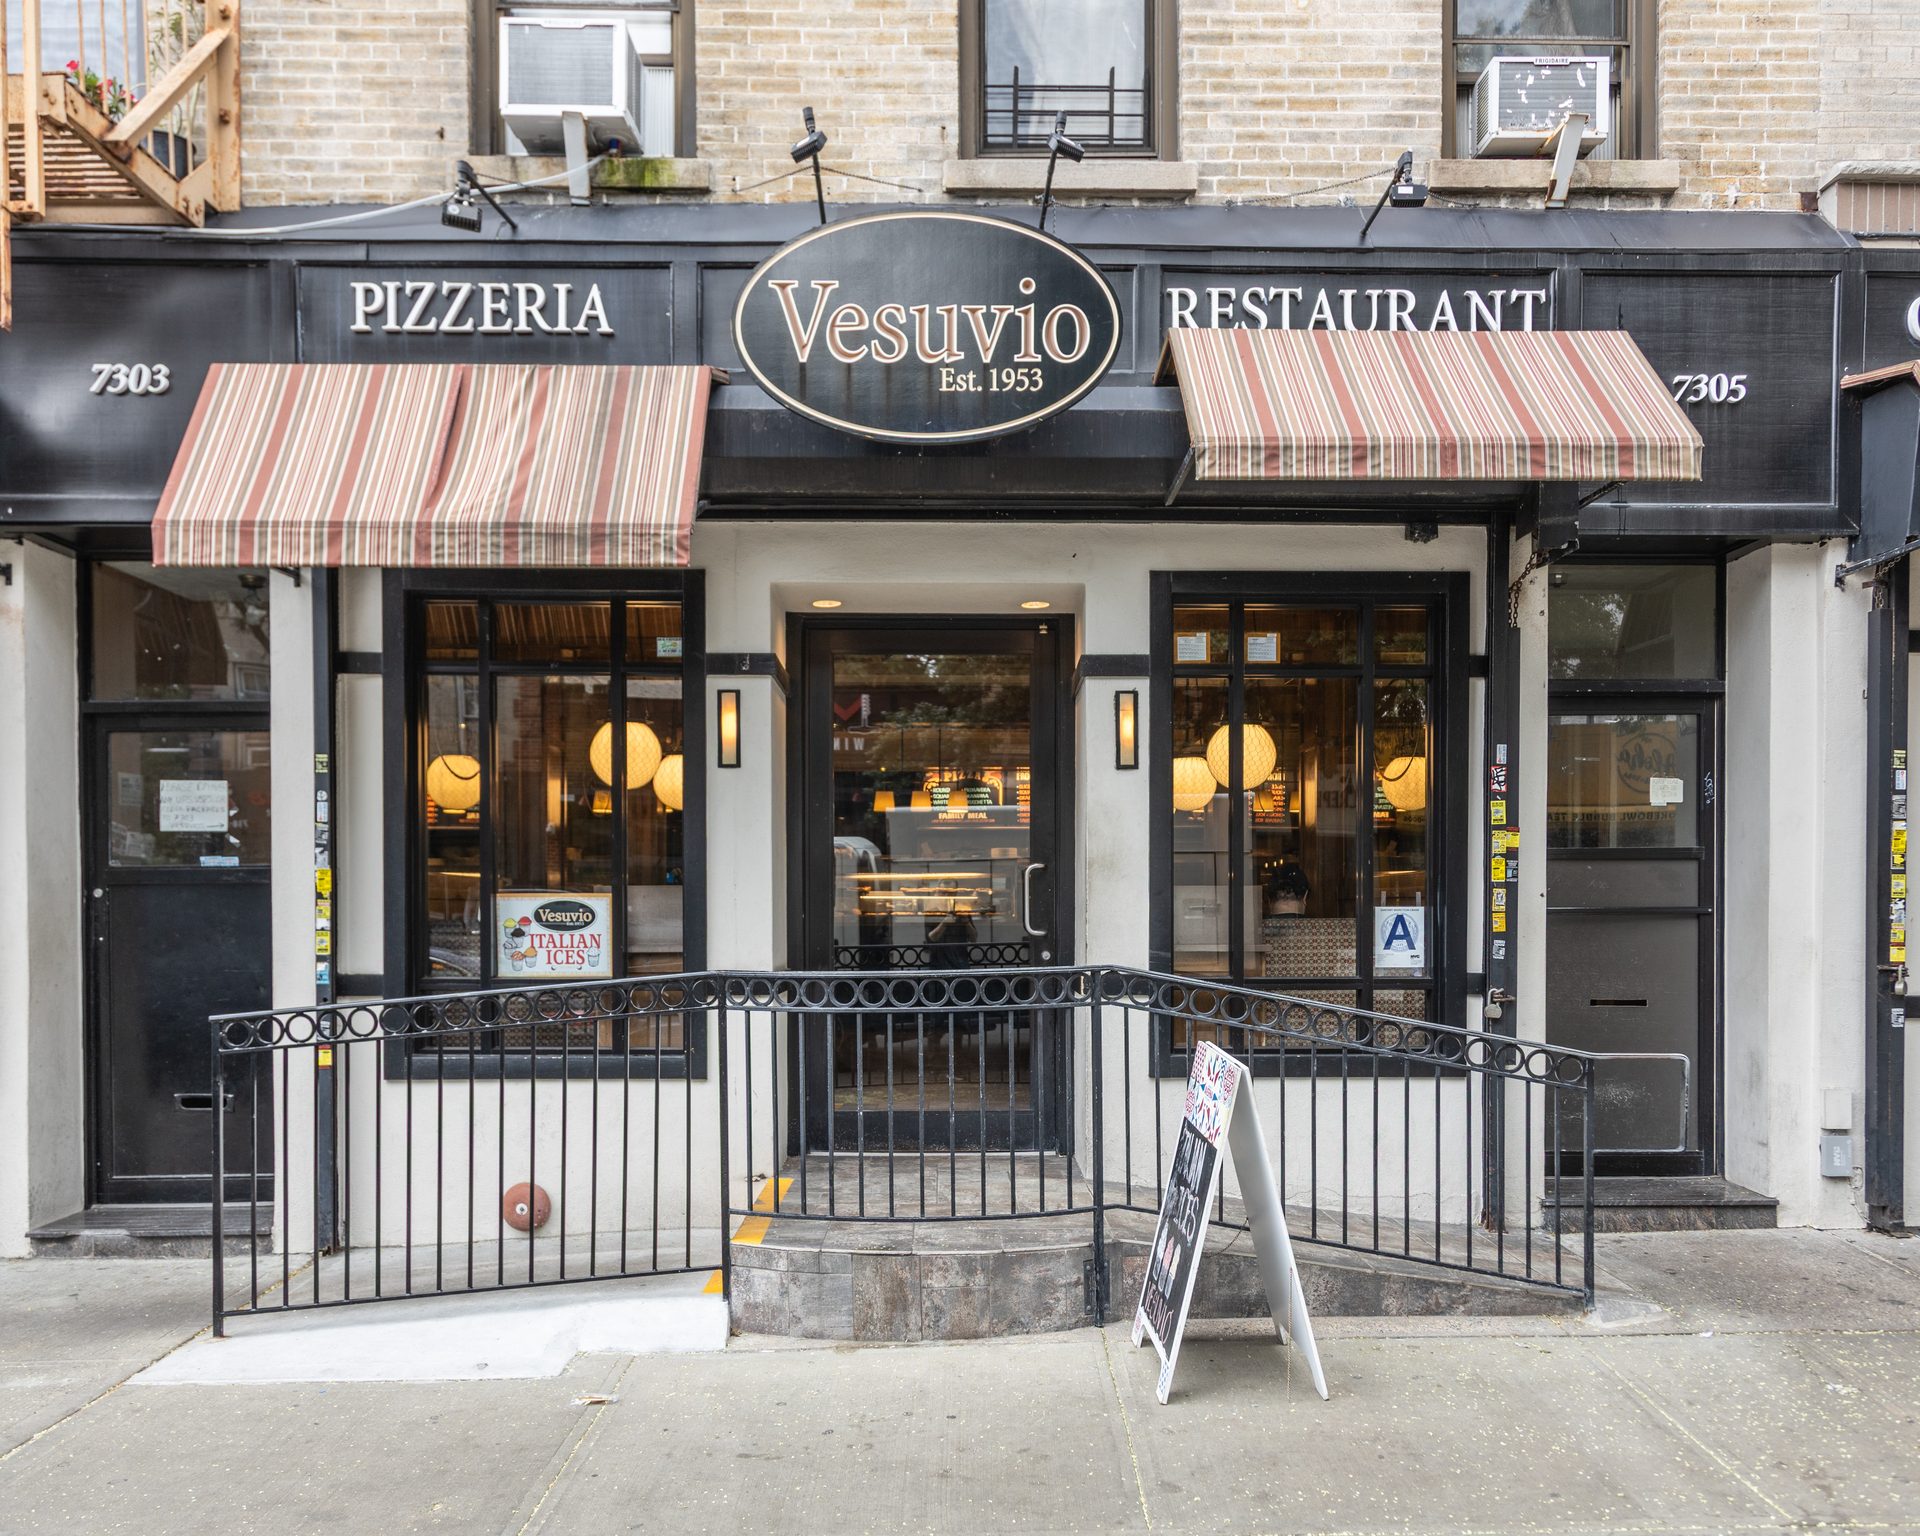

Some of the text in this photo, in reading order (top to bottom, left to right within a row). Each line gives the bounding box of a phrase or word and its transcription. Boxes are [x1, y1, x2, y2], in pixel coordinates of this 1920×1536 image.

[350, 281, 615, 335] PIZZERIA
[768, 277, 1091, 364] Vesuvio
[1166, 286, 1547, 332] RESTAURANT
[89, 363, 171, 395] 7303
[939, 367, 1044, 392] Est. 1953
[1672, 373, 1748, 403] 7305
[538, 908, 592, 922] Vesuvio
[529, 934, 602, 950] ITALIAN
[1383, 914, 1416, 950] A
[545, 950, 585, 965] ICES
